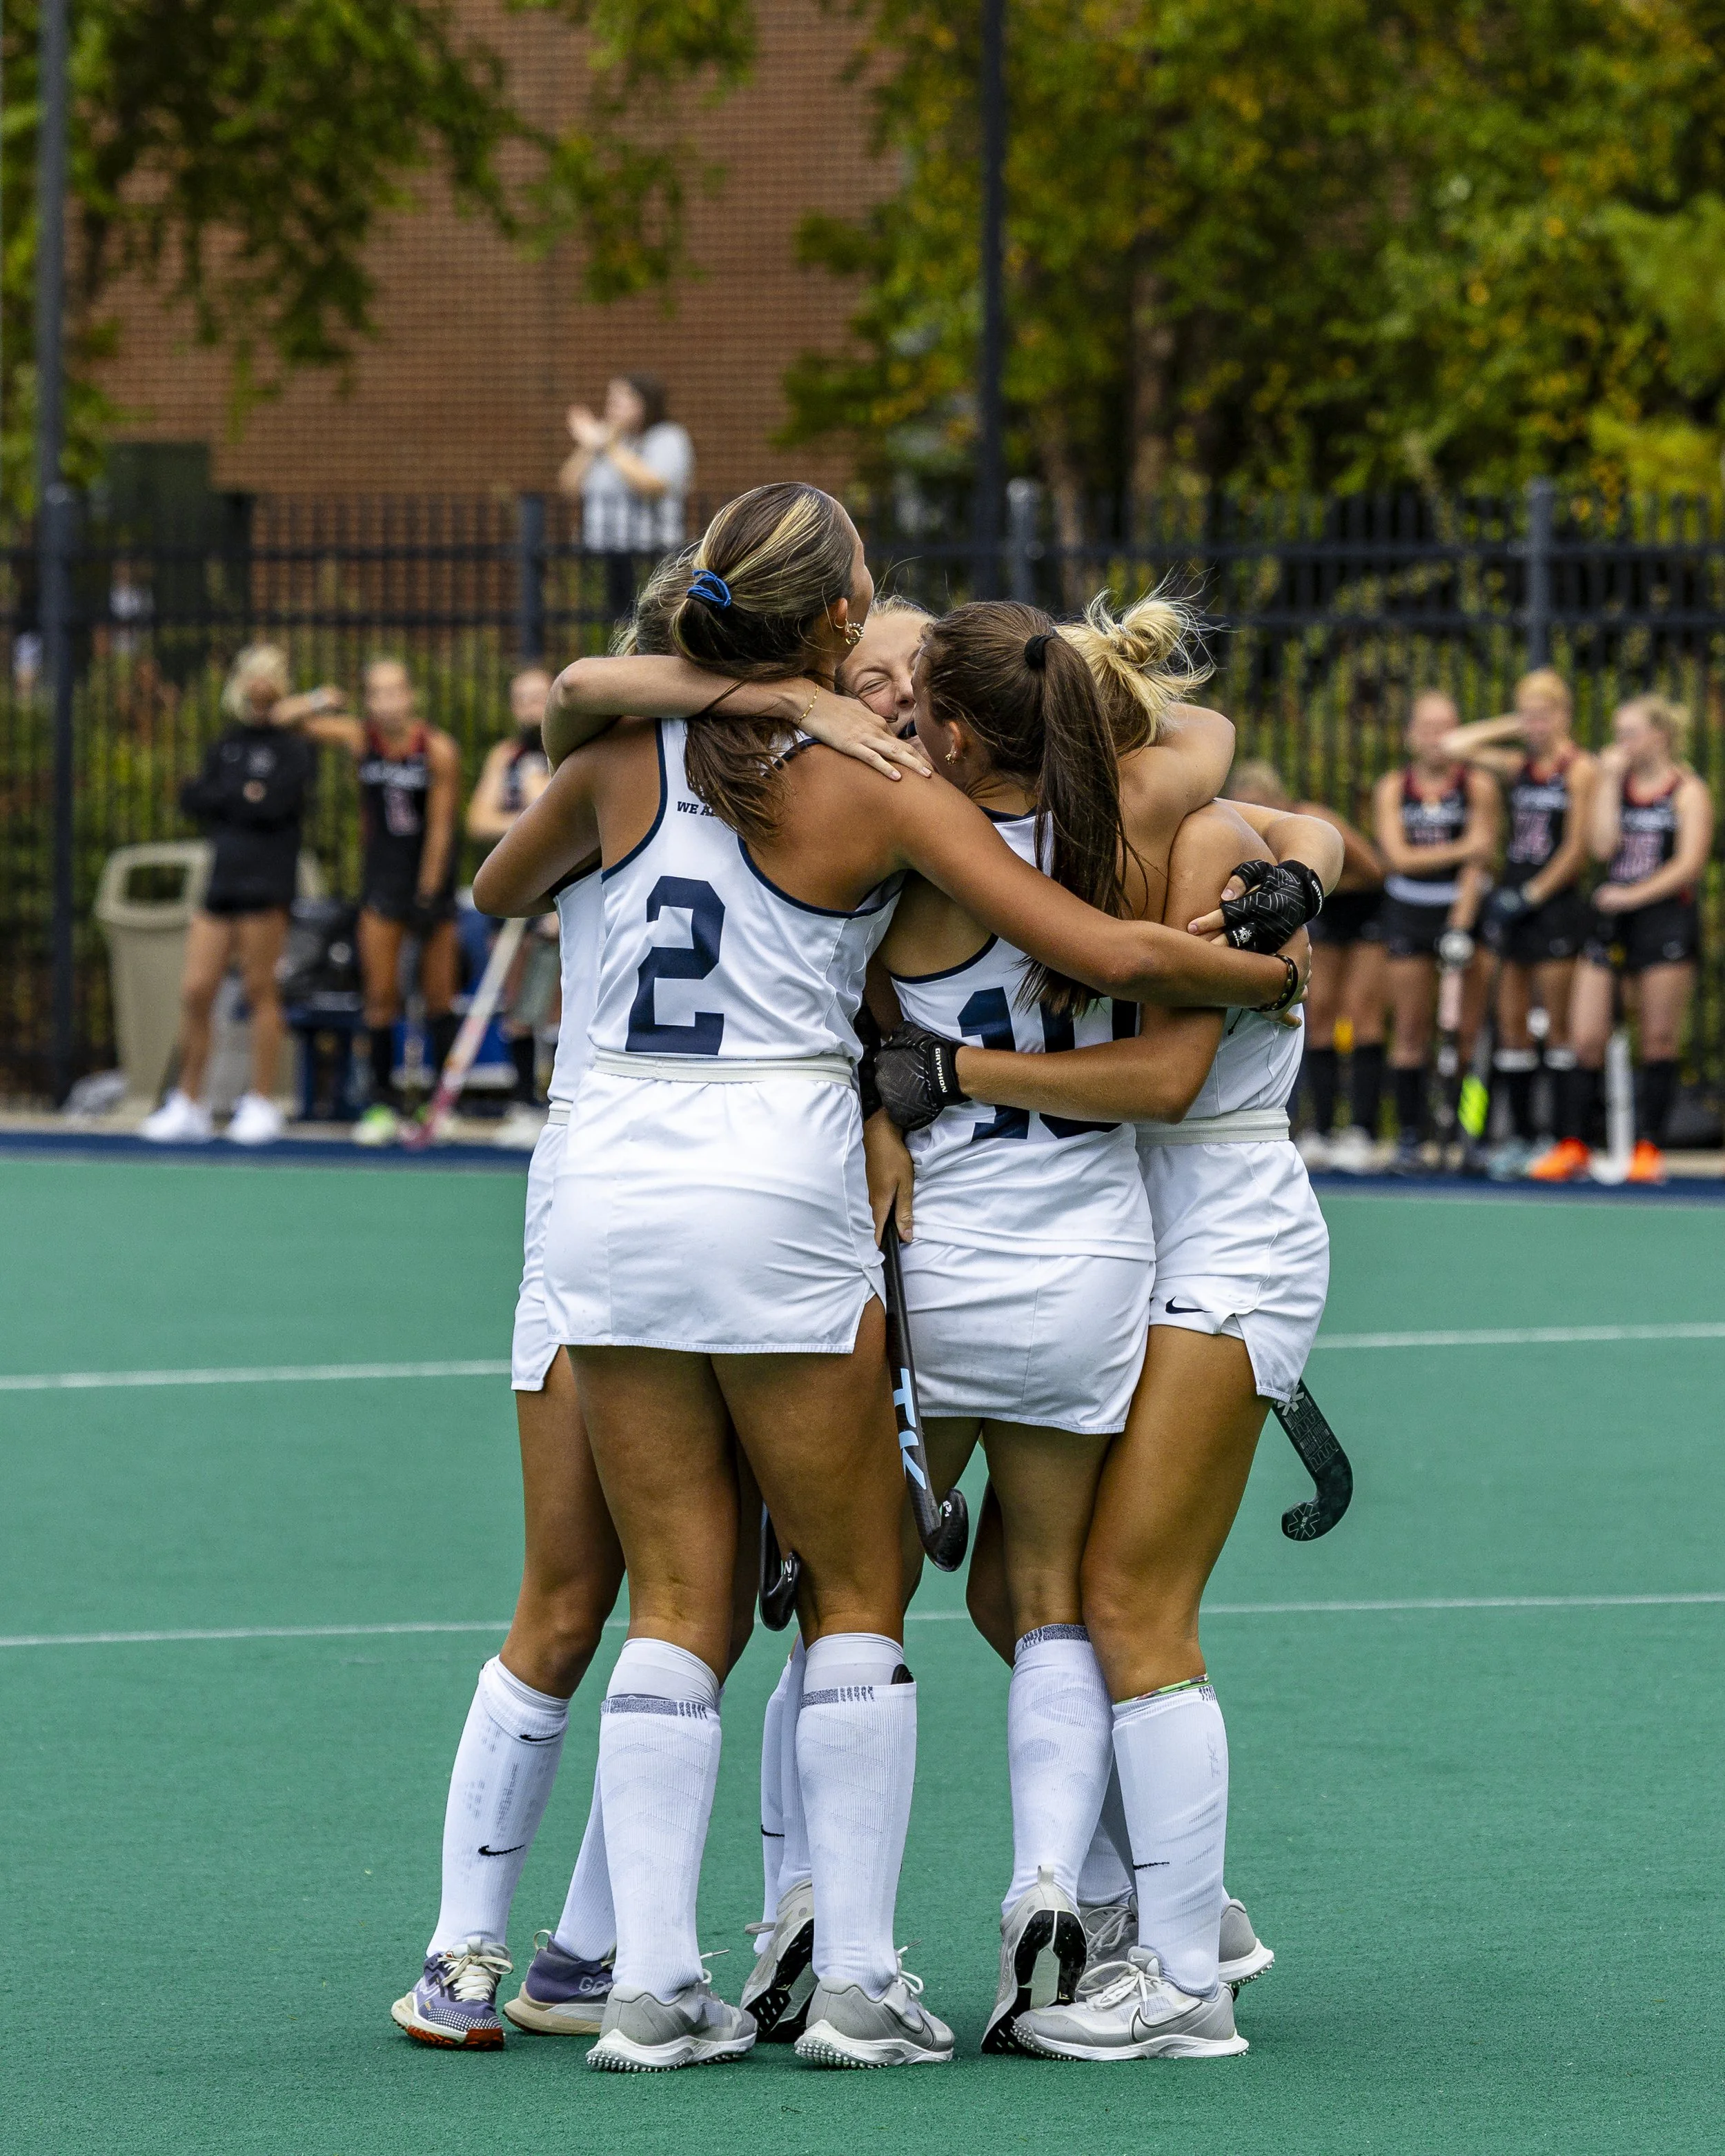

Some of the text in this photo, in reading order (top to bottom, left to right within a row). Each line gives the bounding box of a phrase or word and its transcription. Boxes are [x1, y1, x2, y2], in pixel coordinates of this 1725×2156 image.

[677, 801, 699, 814] WE
[625, 876, 725, 1056] 2
[935, 1048, 947, 1093] GRYPHON
